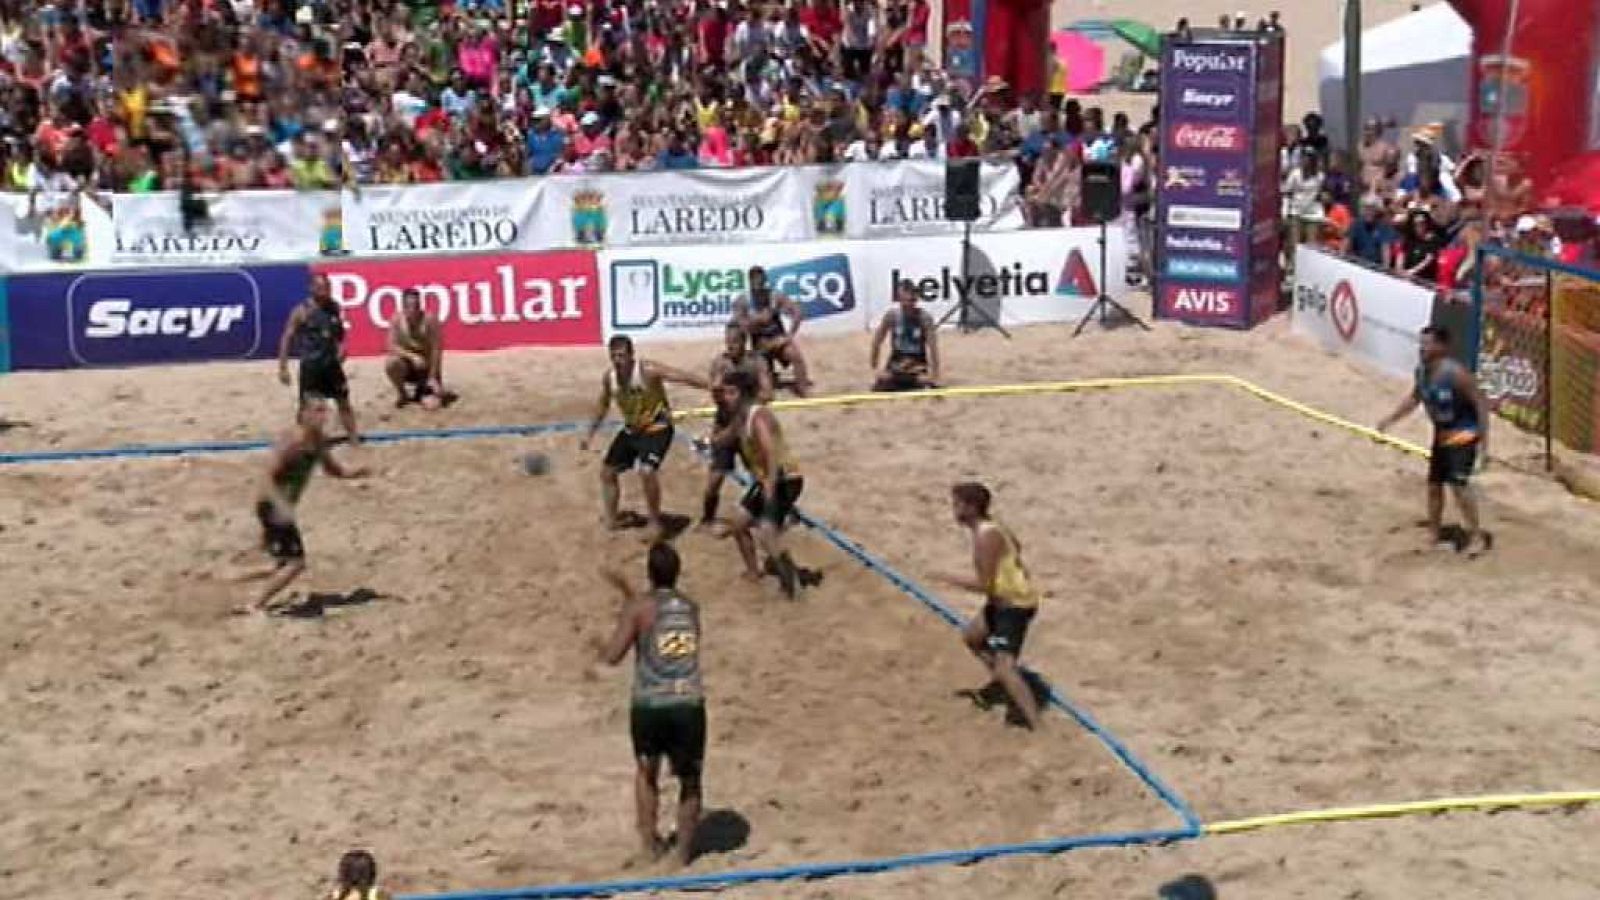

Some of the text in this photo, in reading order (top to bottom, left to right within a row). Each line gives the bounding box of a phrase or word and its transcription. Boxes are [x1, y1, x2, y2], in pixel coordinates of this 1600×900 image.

[369, 218, 518, 250] LAREDO
[632, 203, 764, 234] LAREDO
[662, 264, 745, 299] Lyca
[776, 272, 846, 309] CSQ
[891, 262, 1049, 302] helvetia
[662, 298, 732, 317] mobil
[1174, 288, 1232, 313] AVIS
[85, 298, 245, 338] Sacyr
